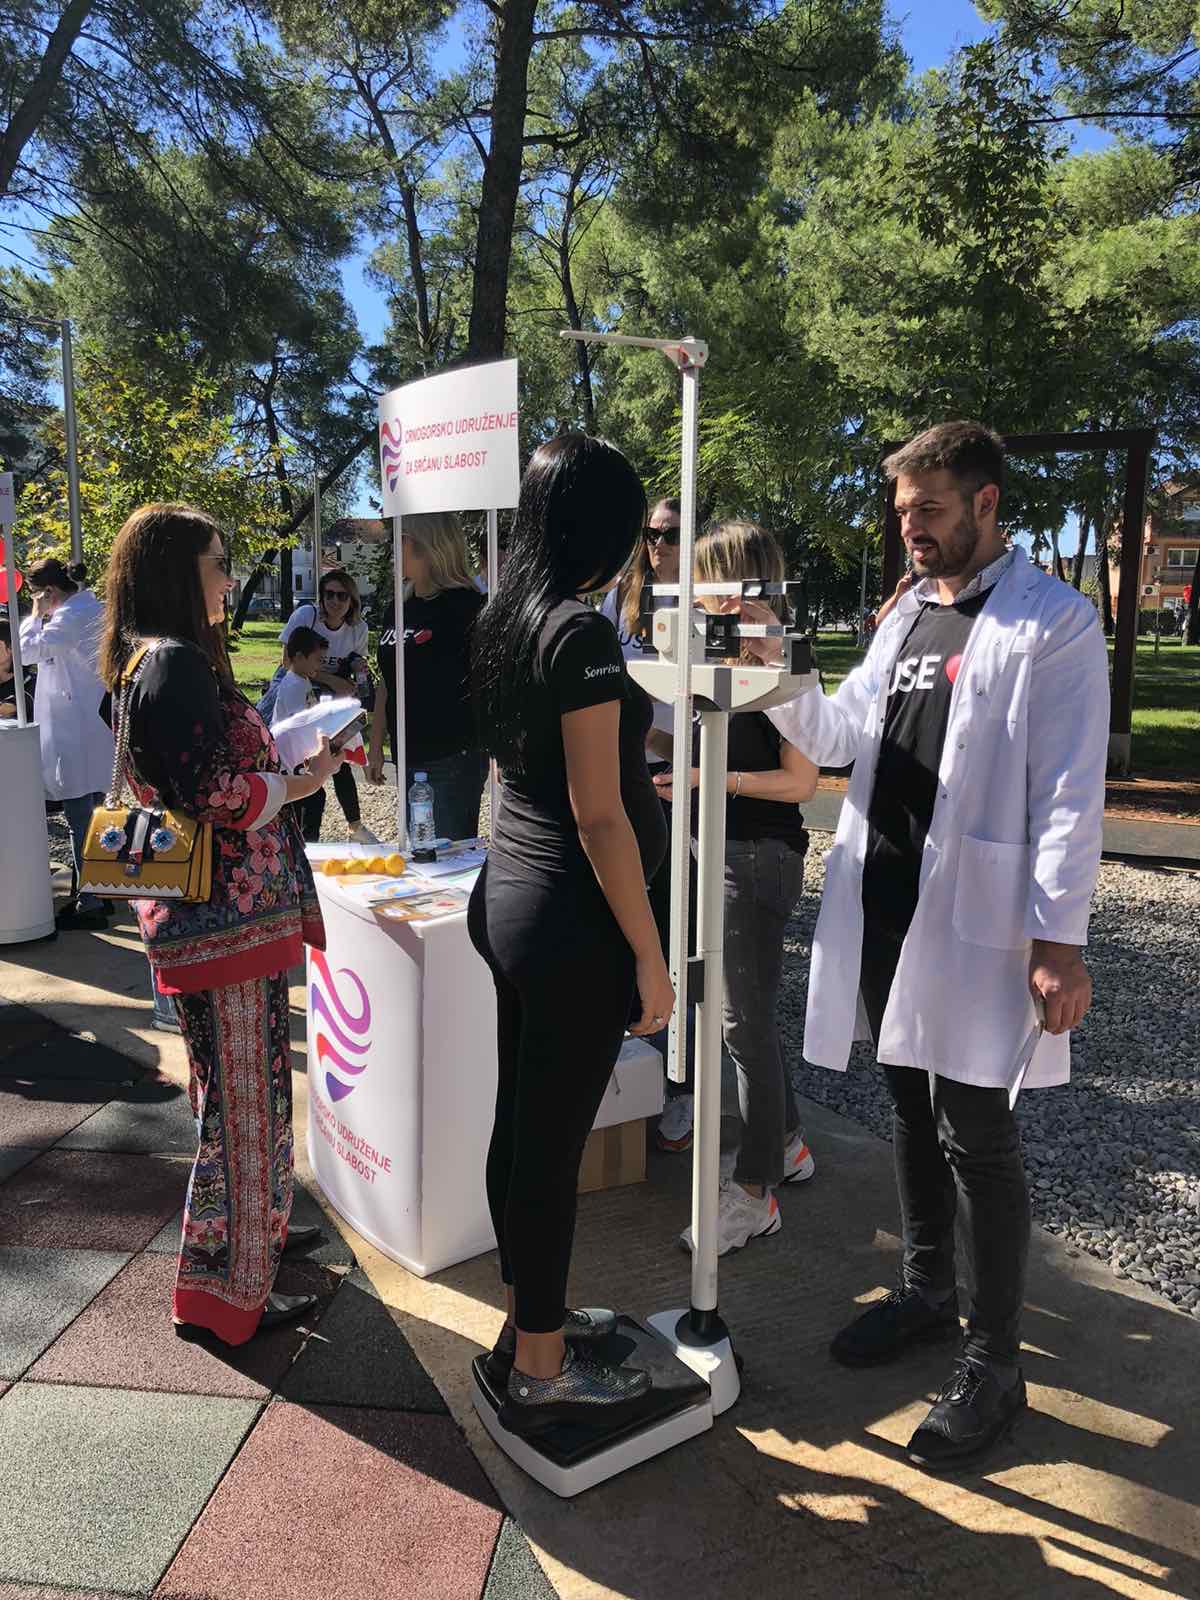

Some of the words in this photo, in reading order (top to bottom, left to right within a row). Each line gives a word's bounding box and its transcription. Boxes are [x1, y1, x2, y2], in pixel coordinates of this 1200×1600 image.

[455, 412, 518, 435] UDRUŽENJE
[444, 451, 487, 470] SLABOST
[583, 663, 621, 680] Sonrisa
[337, 1120, 391, 1173] UDRUŽENJE
[336, 1142, 377, 1183] SLABOST
